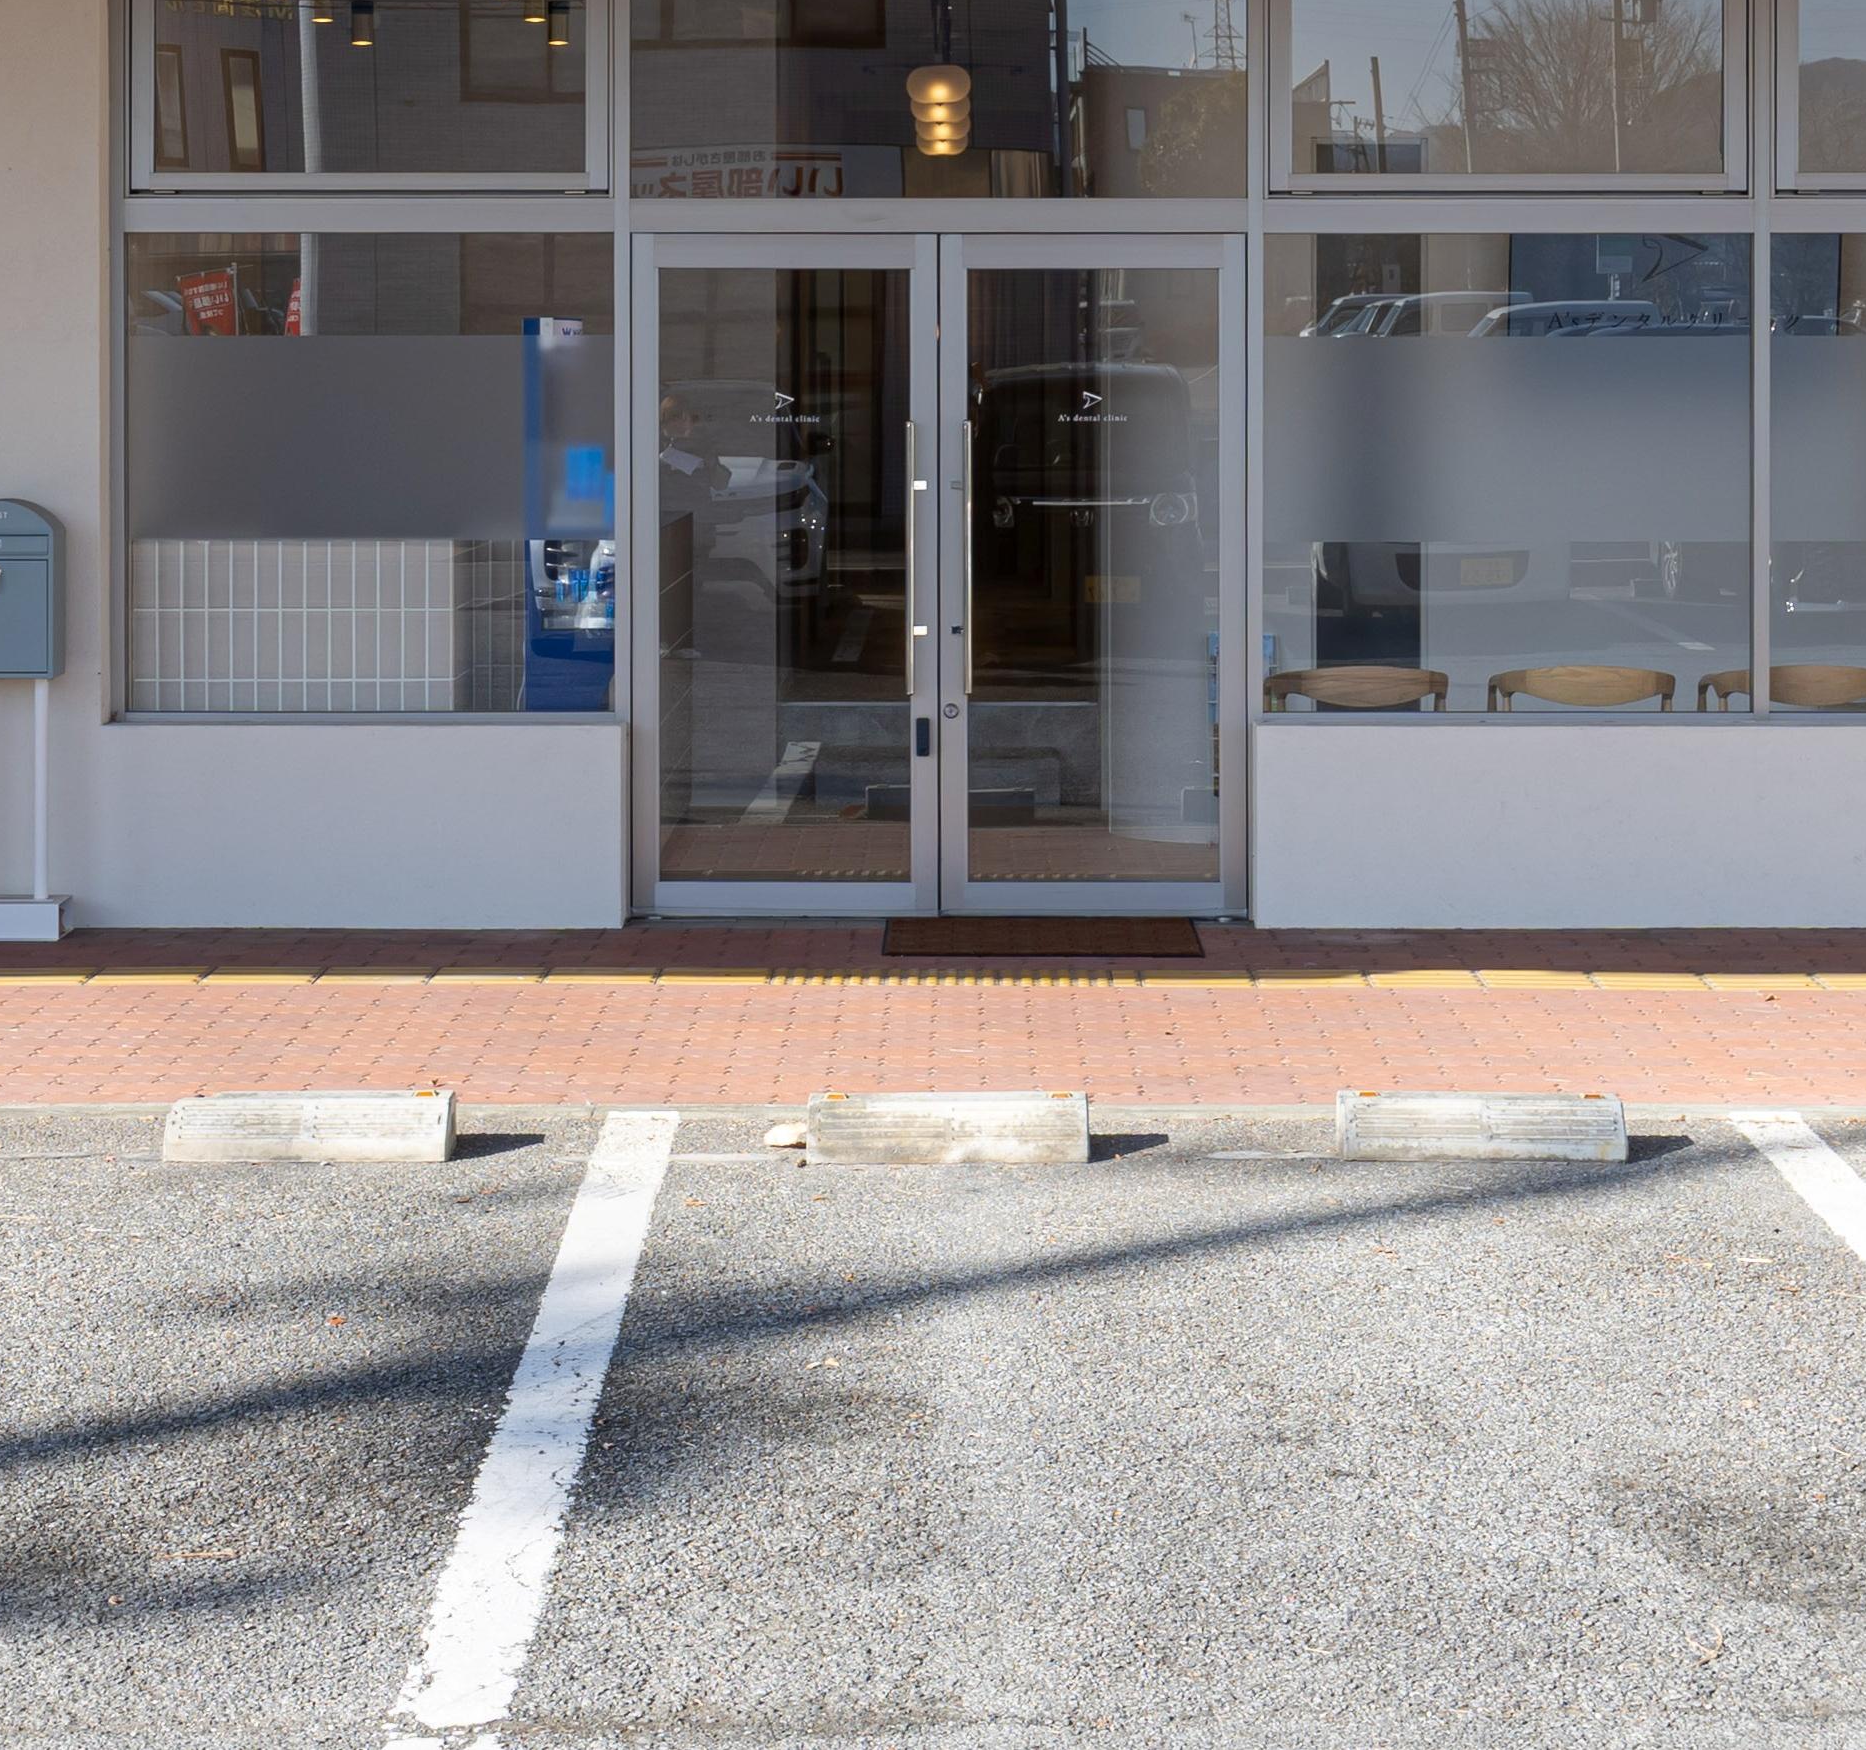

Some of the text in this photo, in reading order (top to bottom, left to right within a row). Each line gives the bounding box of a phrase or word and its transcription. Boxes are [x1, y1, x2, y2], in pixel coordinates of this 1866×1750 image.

[766, 414, 793, 423] dental
[795, 414, 821, 423] clinic
[1073, 413, 1102, 422] dental
[1104, 413, 1129, 422] clinic
